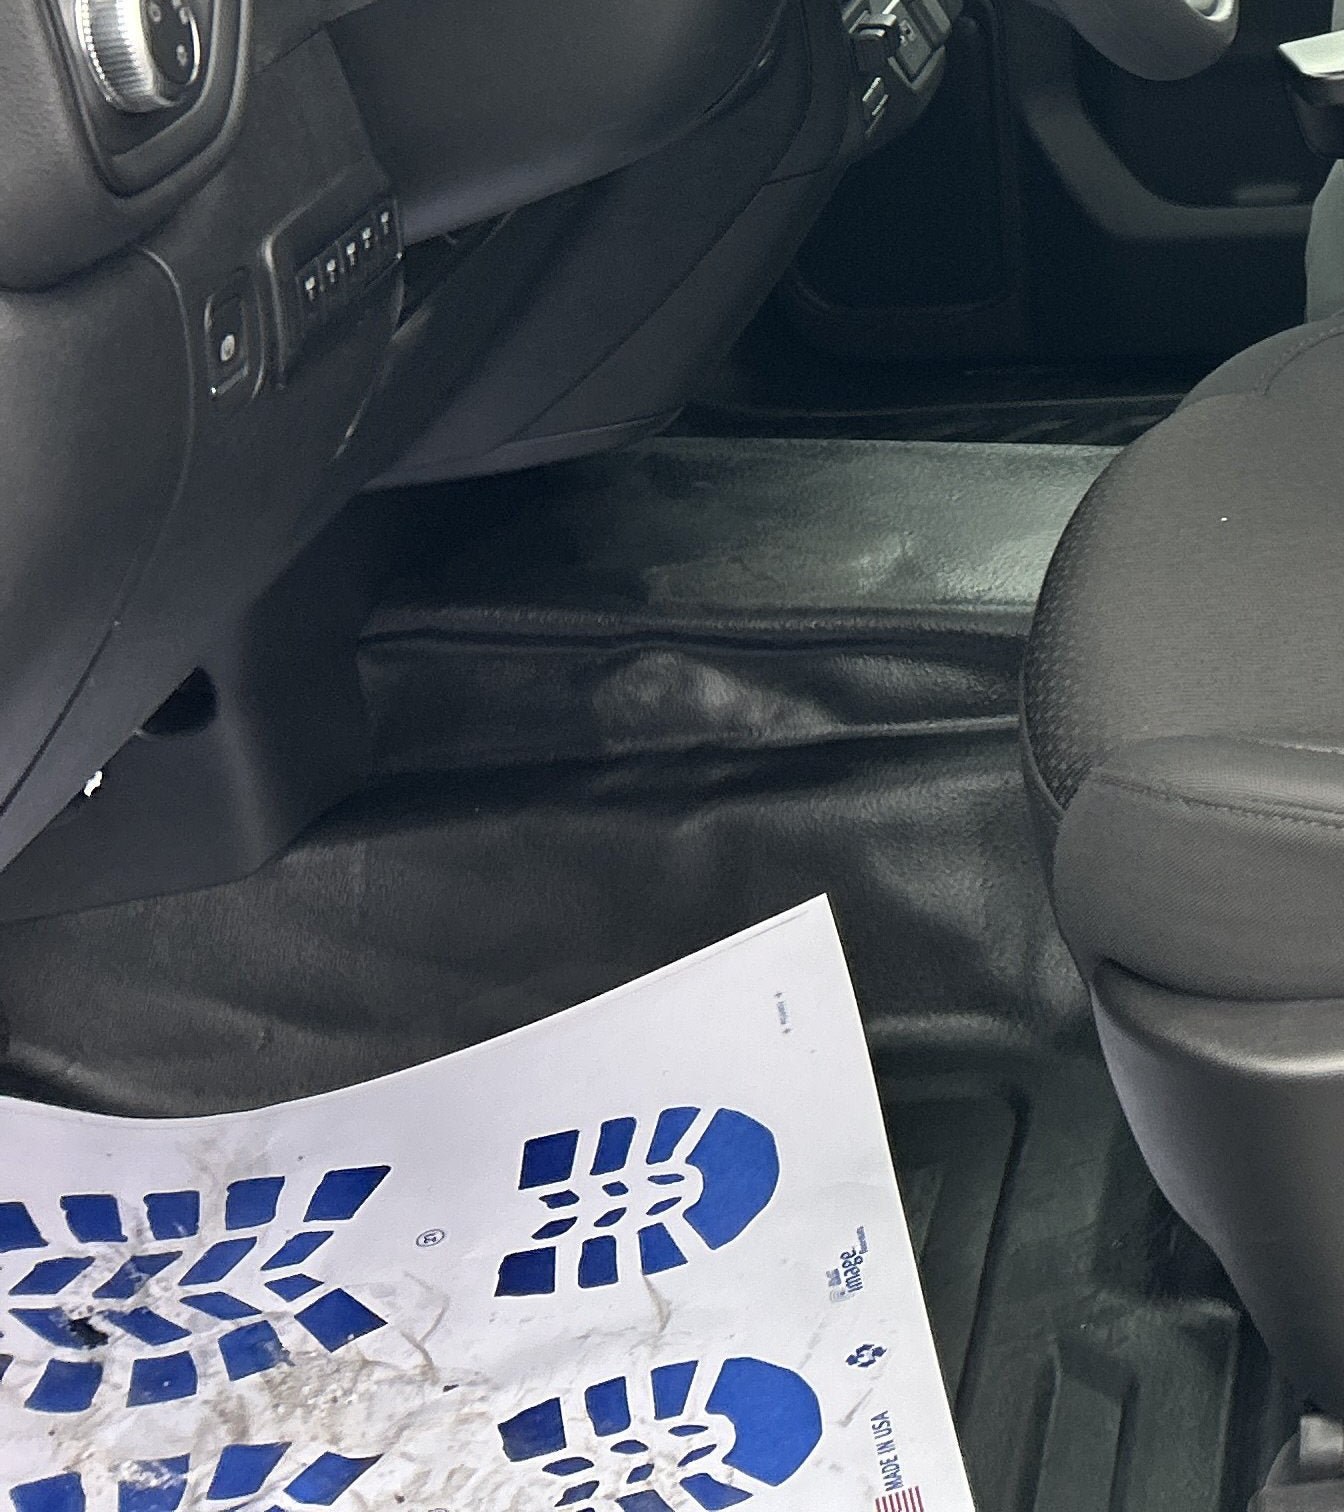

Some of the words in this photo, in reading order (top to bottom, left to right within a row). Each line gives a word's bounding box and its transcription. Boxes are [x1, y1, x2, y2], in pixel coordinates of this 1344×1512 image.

[840, 1247, 863, 1293] image
[870, 1410, 893, 1439] USA
[876, 1439, 896, 1455] IN
[879, 1454, 904, 1491] MADE
